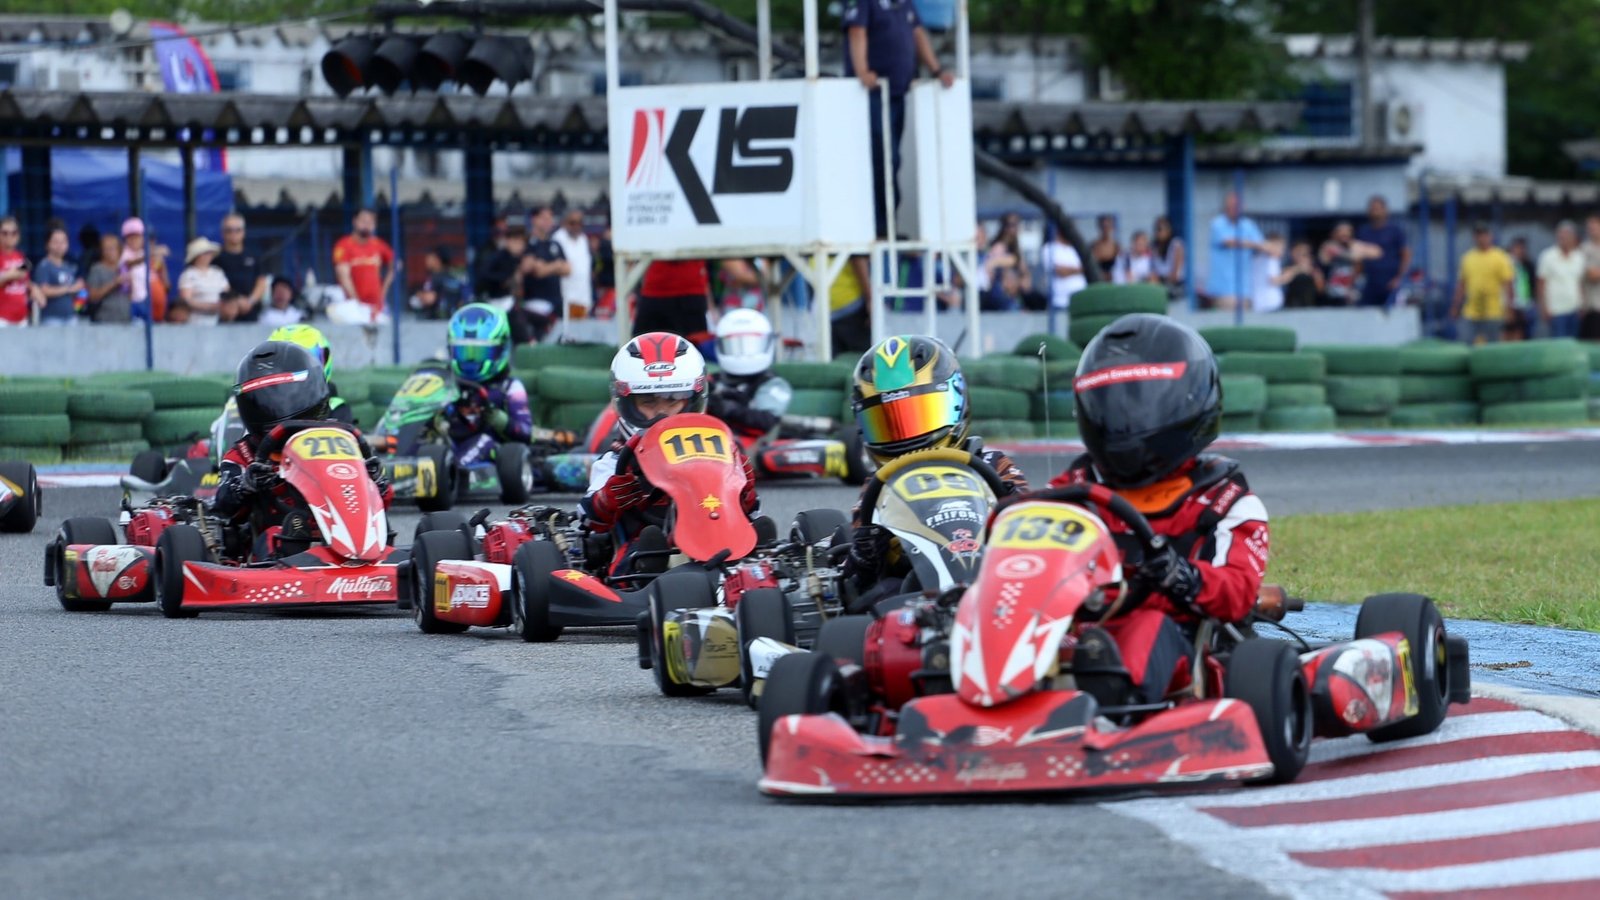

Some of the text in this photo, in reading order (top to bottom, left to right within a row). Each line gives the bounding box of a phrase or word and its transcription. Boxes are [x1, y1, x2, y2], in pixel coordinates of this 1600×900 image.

[303, 436, 356, 457] 279
[664, 433, 725, 457] 111
[1000, 515, 1086, 546] 139
